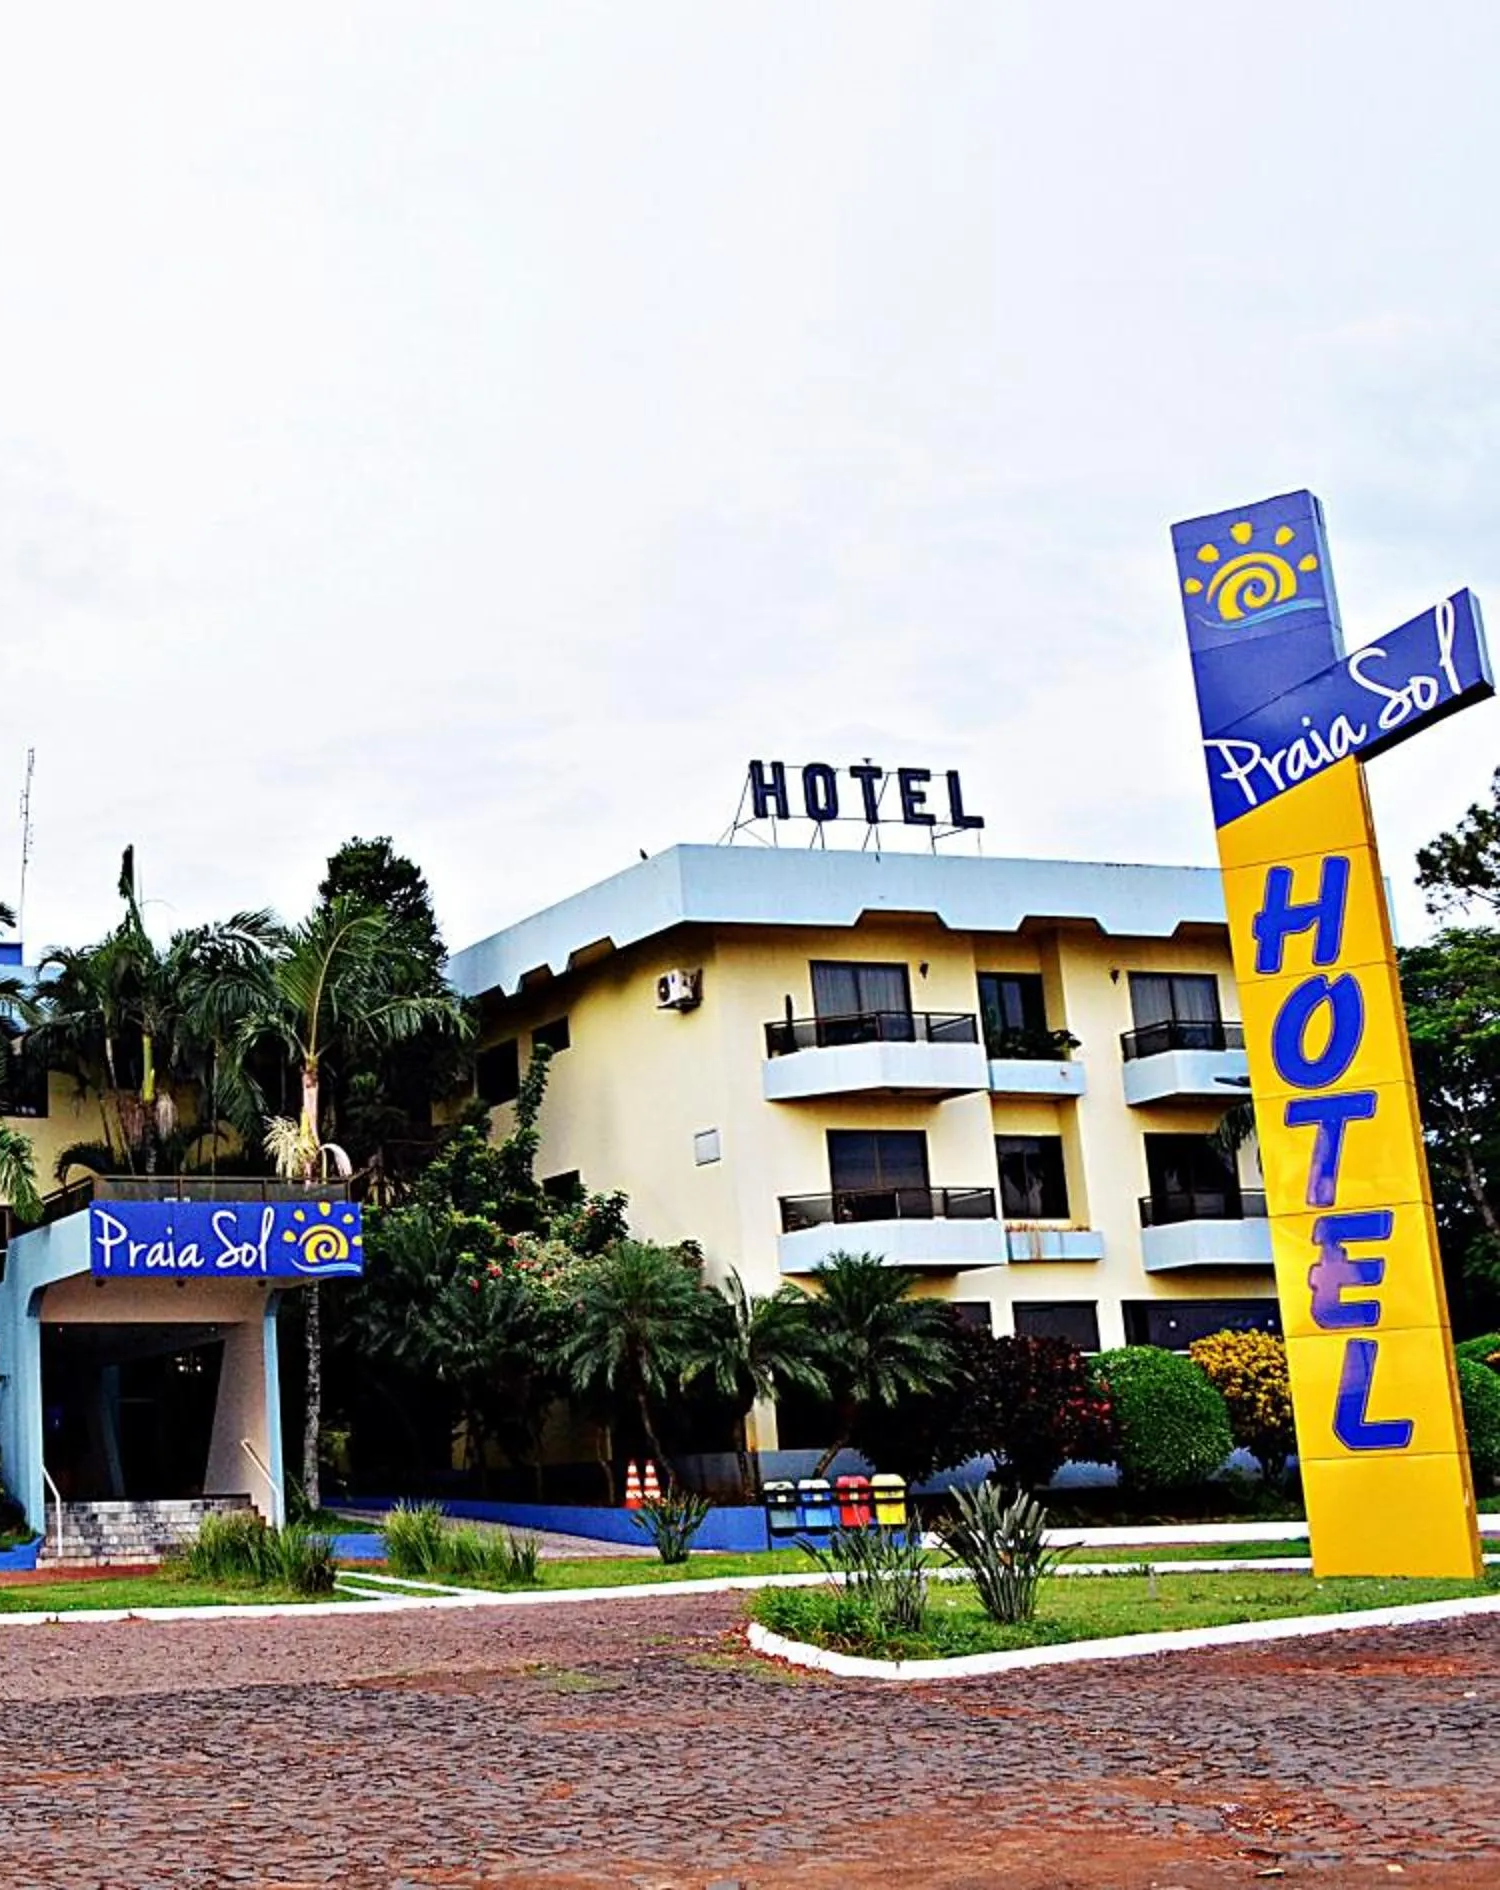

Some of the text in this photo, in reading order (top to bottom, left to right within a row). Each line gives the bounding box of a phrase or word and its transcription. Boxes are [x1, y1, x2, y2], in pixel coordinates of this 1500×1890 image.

[1202, 600, 1463, 805] Praia Sol
[749, 760, 985, 829] HOTEL
[1252, 855, 1414, 1452] HOTEL
[94, 1206, 275, 1272] Praia Sol
